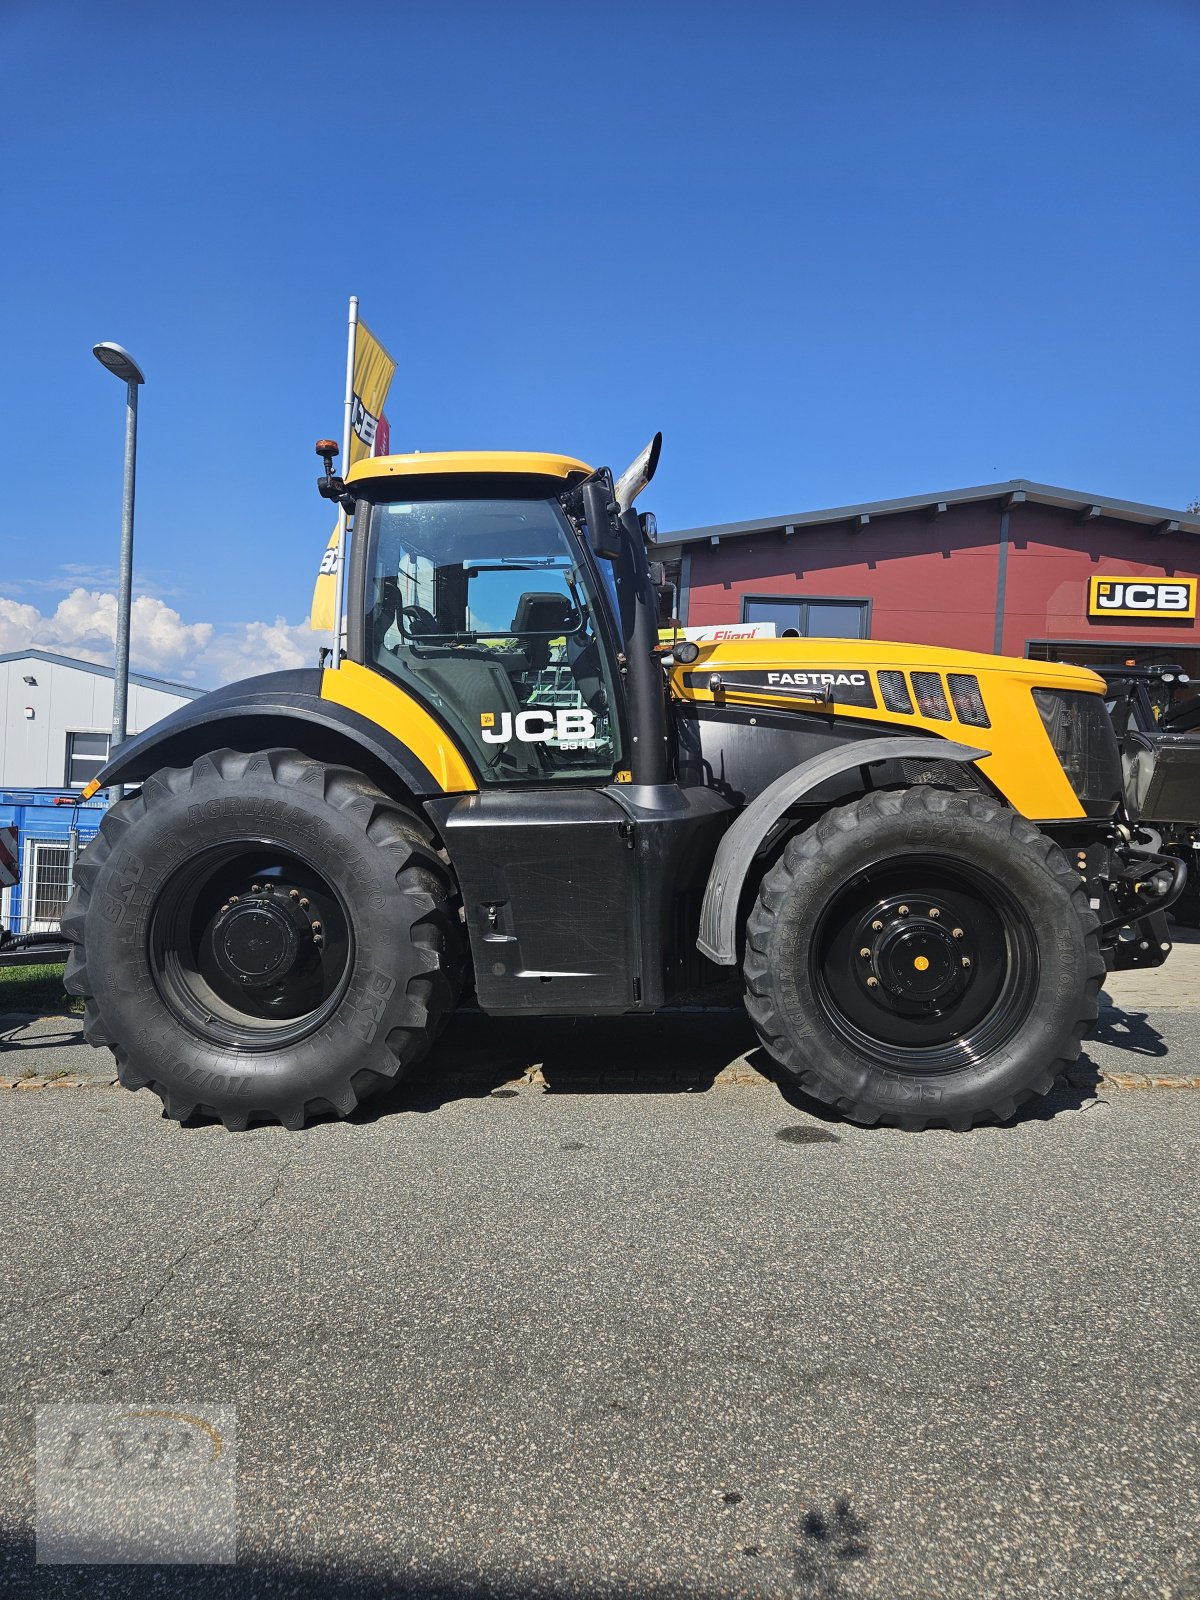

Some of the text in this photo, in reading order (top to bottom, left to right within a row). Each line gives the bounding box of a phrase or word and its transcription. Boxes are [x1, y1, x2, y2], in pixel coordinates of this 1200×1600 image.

[1099, 584, 1187, 610] JCB
[767, 673, 865, 686] FASTRAC
[481, 708, 595, 743] JCB
[560, 741, 596, 750] 8310
[186, 796, 331, 838] AGRIMAX
